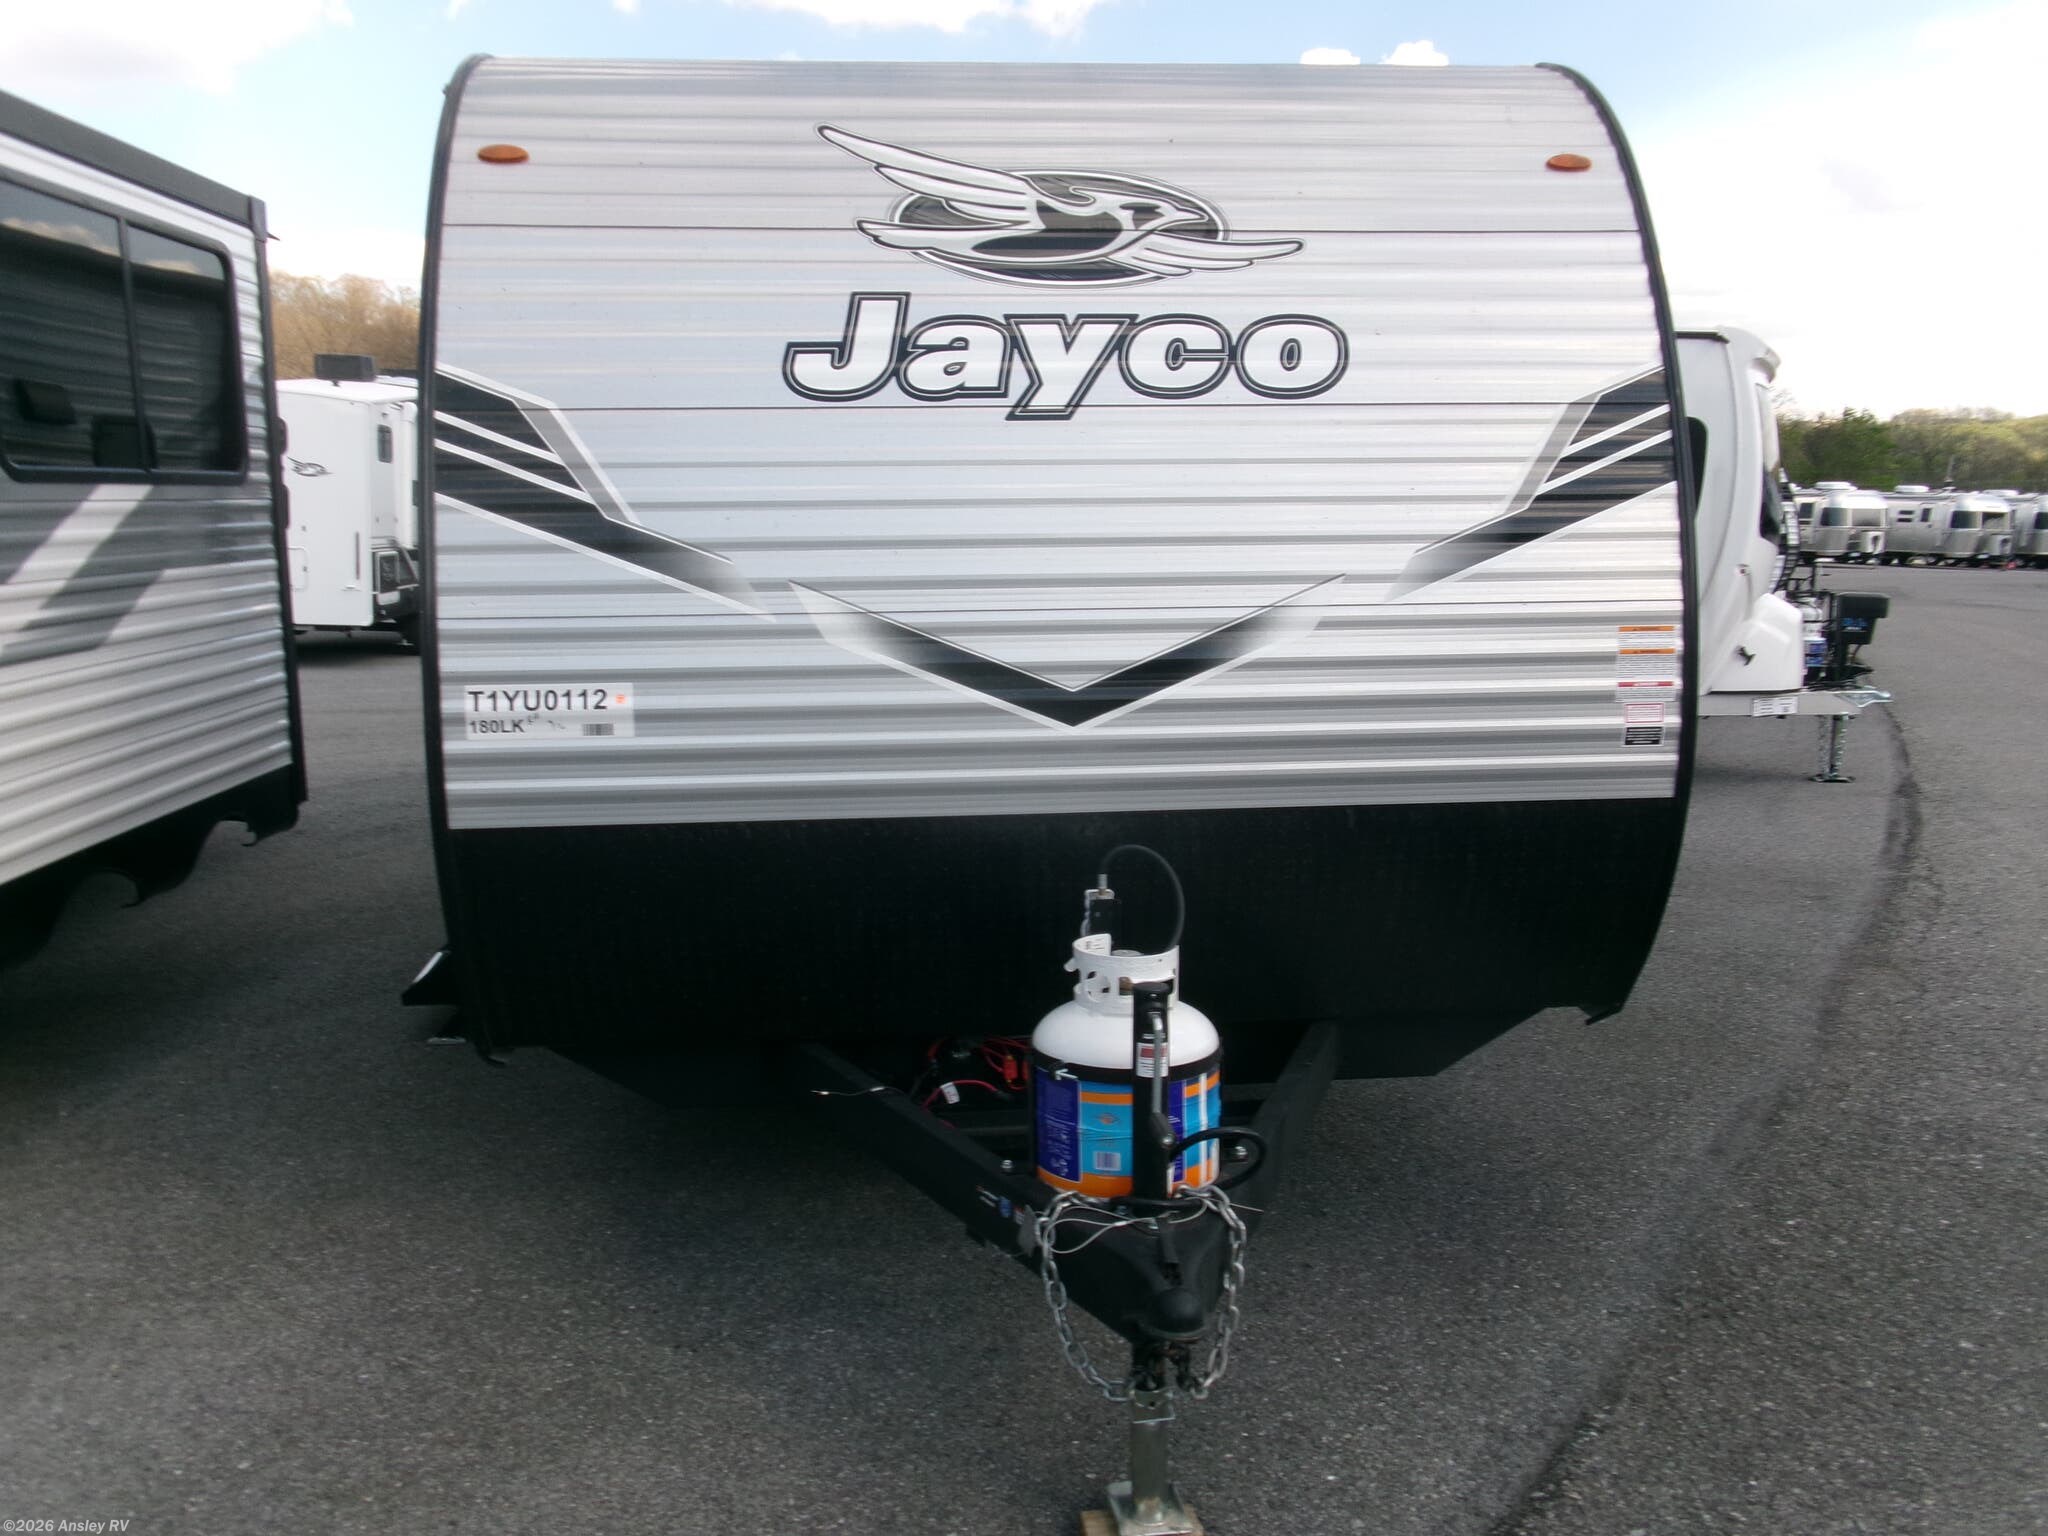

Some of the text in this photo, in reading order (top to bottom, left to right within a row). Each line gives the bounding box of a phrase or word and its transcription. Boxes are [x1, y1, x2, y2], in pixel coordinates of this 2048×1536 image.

[782, 291, 1350, 421] Jayco
[467, 688, 608, 712] T1YU0112
[469, 719, 525, 734] 180LK
